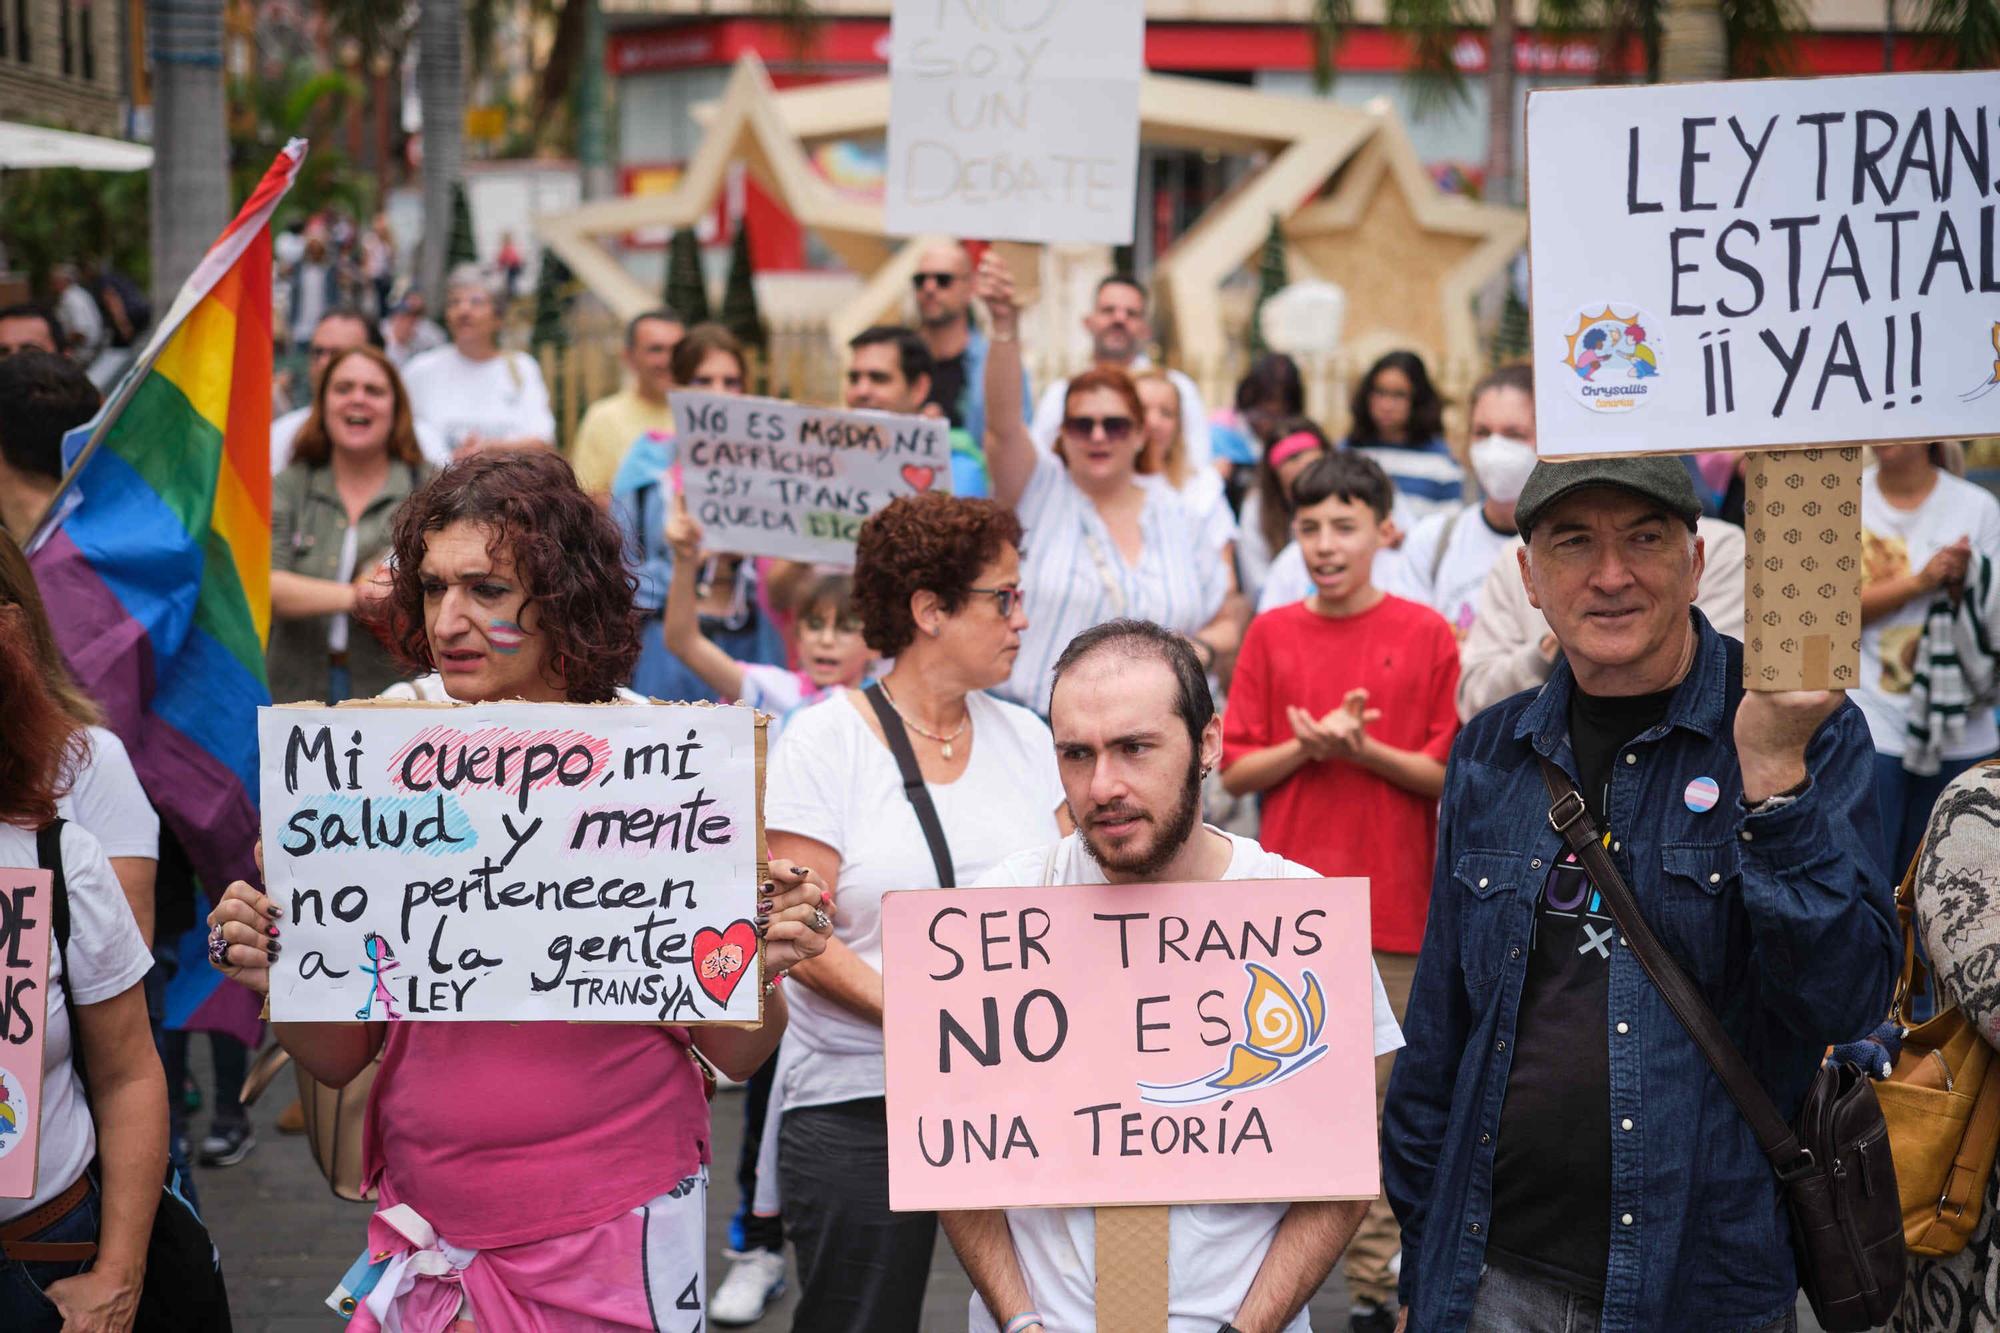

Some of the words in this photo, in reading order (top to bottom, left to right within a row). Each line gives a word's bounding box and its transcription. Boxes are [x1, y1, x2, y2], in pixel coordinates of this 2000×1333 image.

[909, 37, 1052, 84] SOY
[947, 89, 1031, 133] UN
[903, 138, 1119, 213] DEBATE
[1627, 113, 1780, 215] LEY
[1796, 105, 2000, 206] TRAN
[1669, 204, 2000, 318] ESTATAL
[686, 402, 728, 434] NO
[747, 411, 786, 442] ES
[1581, 384, 1648, 397] Chrysallis
[703, 469, 753, 497] SOY
[769, 479, 870, 515] TRANS
[284, 724, 363, 794] Mi
[400, 740, 615, 814] cuerpo,
[623, 728, 704, 781] mi
[282, 794, 466, 858] salud
[500, 812, 543, 867] y
[569, 787, 735, 853] mente
[292, 884, 369, 927] no
[400, 856, 698, 944] pertenecen
[298, 950, 349, 980] a
[426, 914, 503, 975] la
[531, 910, 695, 992] gente
[928, 906, 1052, 982] SER
[1093, 908, 1328, 969] TRANS
[407, 975, 479, 1014] LEY
[938, 987, 1069, 1074] NO
[1135, 988, 1233, 1053] ES
[917, 1112, 1040, 1168] UNA
[1073, 1100, 1274, 1157] TEORÍA
